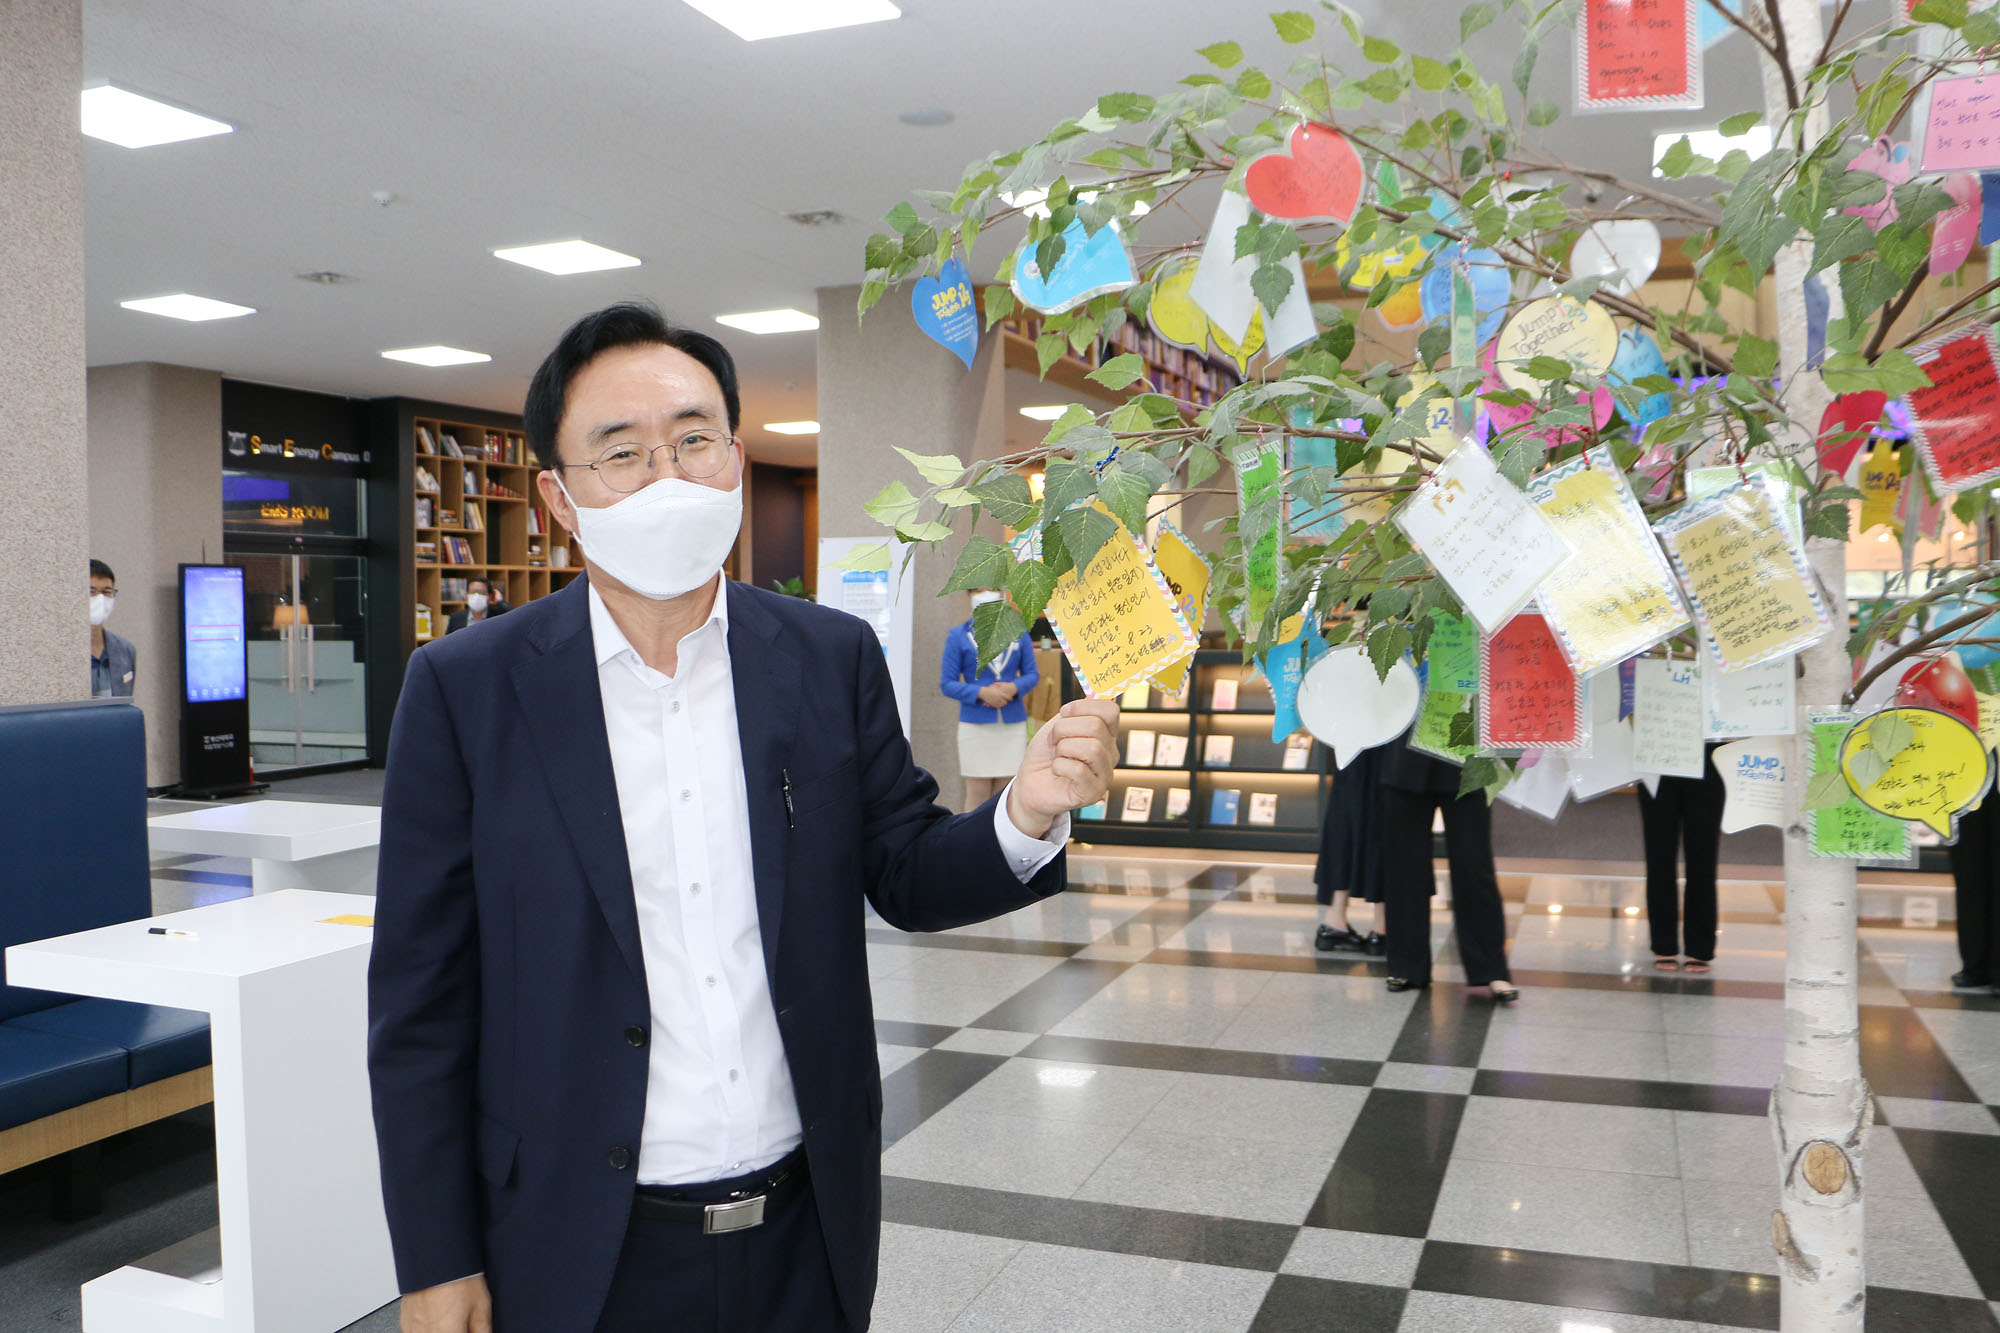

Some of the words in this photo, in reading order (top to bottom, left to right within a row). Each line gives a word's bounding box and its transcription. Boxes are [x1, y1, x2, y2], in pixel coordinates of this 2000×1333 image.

[931, 287, 957, 310] JUMP
[1518, 306, 1557, 341] Jump
[1555, 303, 1588, 323] 123
[1508, 320, 1576, 357] Together
[250, 434, 282, 455] Smart
[283, 439, 321, 459] Energy
[321, 443, 361, 463] Campus
[291, 504, 330, 521] ROOM
[1672, 672, 1691, 685] LH
[1737, 754, 1779, 771] JUMP
